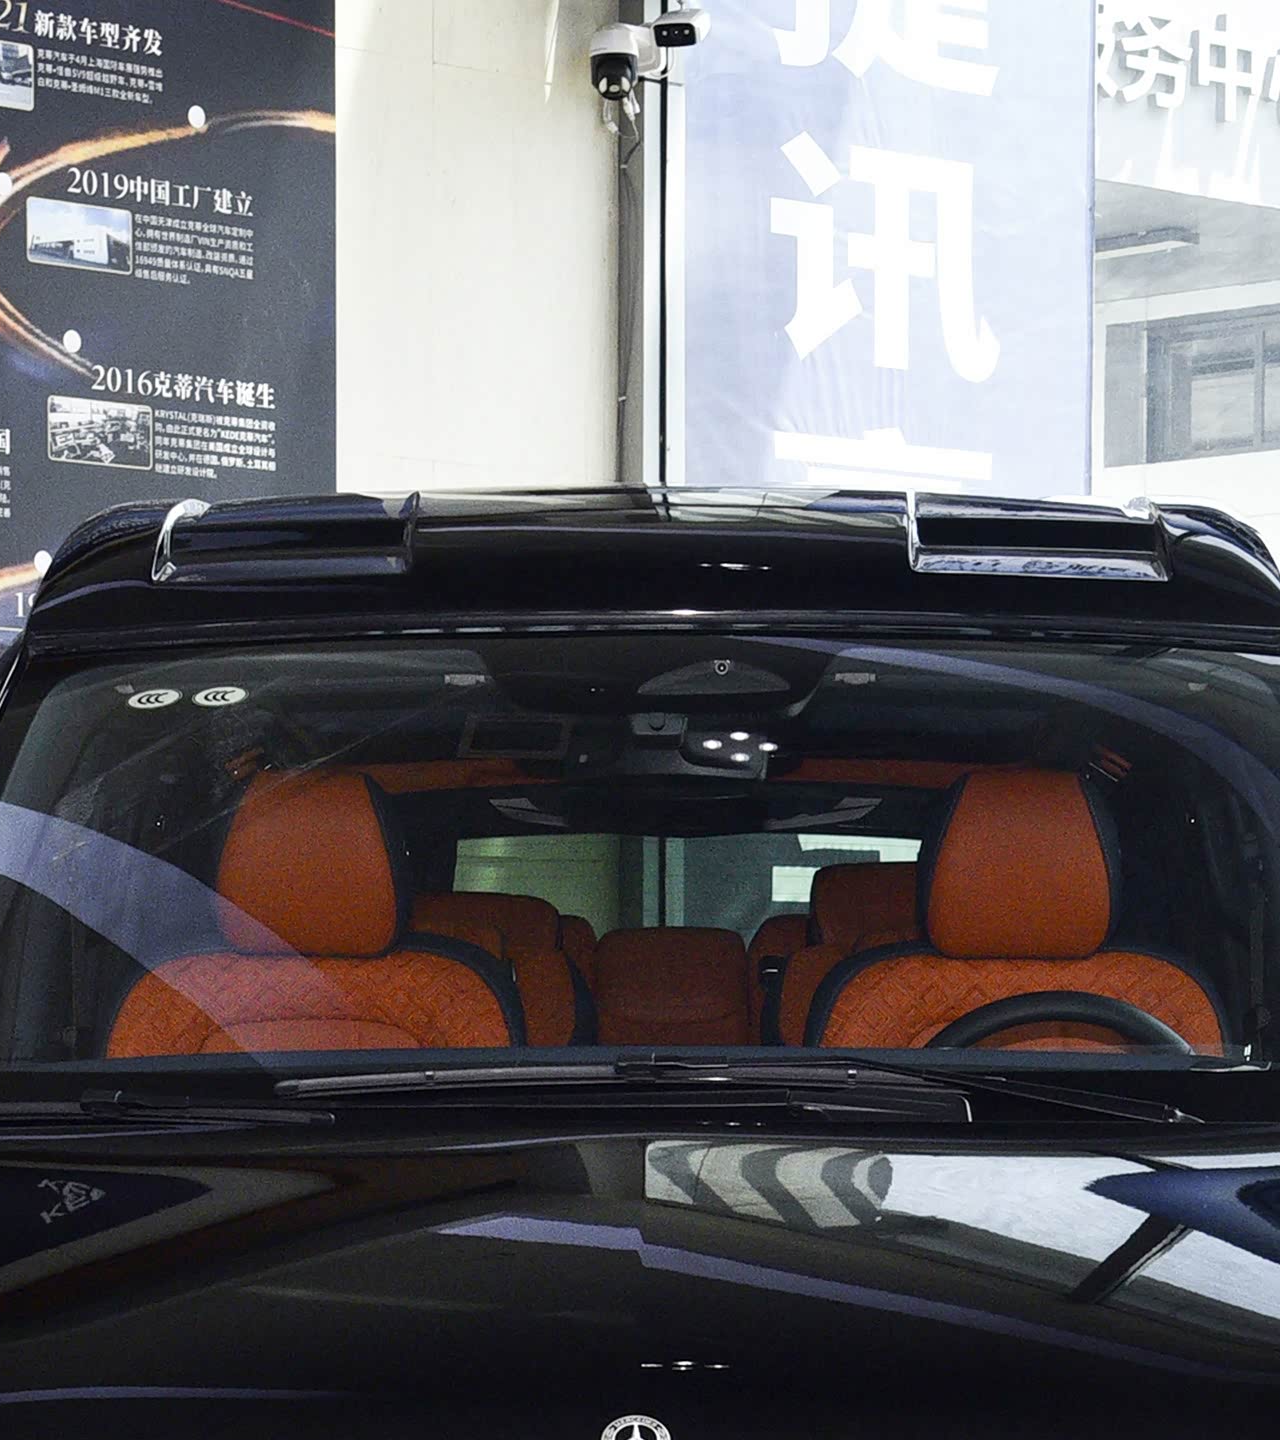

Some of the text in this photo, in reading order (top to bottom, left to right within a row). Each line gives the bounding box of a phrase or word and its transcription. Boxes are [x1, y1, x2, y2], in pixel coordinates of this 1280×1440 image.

[67, 166, 254, 217] 2019中国工厂建立
[91, 364, 276, 410] 2016克蒂汽车诞生
